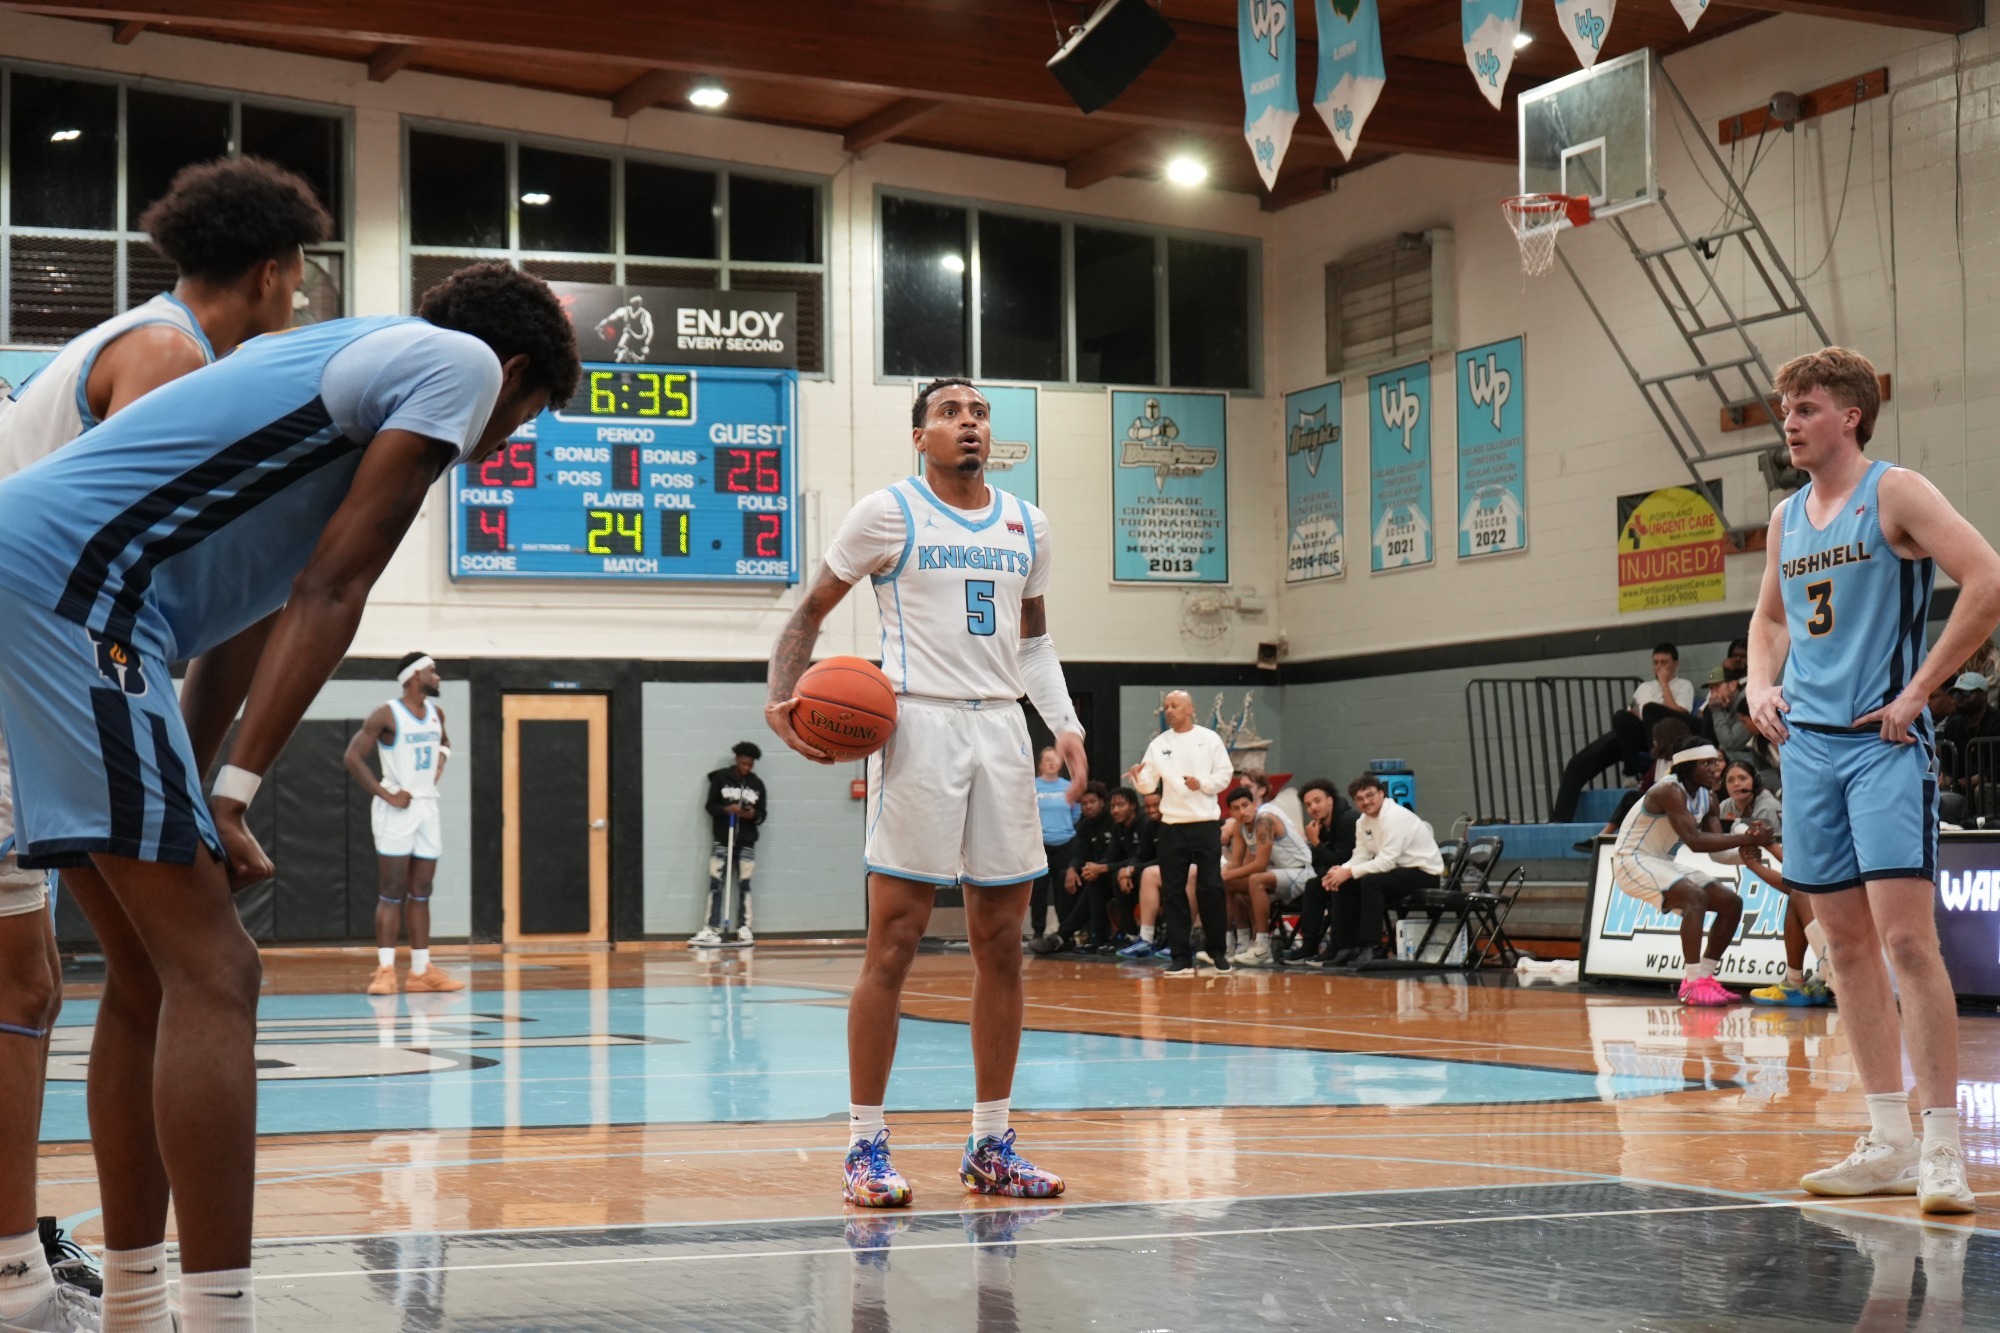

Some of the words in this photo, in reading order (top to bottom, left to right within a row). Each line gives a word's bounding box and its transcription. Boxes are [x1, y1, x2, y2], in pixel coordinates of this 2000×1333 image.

[677, 307, 785, 338] ENJOY
[677, 335, 723, 350] EVERY
[725, 338, 785, 352] SECOND
[590, 371, 689, 417] 6:35
[597, 427, 655, 443] PERIOD
[709, 422, 787, 445] GUEST
[554, 446, 611, 463] BONUS
[642, 449, 697, 465] BONUS
[630, 449, 639, 487] 1
[727, 449, 779, 493] 26
[557, 470, 602, 487] POSS
[650, 473, 695, 488] POSS
[460, 489, 515, 505] FOULS
[583, 492, 644, 508] PLAYER
[654, 493, 696, 509] FOUL
[737, 495, 788, 511] FOULS
[1137, 496, 1203, 506] CASCADE
[1122, 507, 1219, 517] CONFERENCE
[1650, 507, 1693, 521] PORTLAND
[480, 510, 506, 549] 4
[1119, 518, 1223, 528] TOURNAMENT
[1386, 524, 1416, 537] SOCCER
[1474, 515, 1507, 530] SOCCER
[1650, 518, 1686, 536] URGENT
[1688, 513, 1715, 530] CARE
[588, 511, 642, 554] 24
[679, 514, 688, 554] 1
[756, 514, 780, 557] 2
[1128, 529, 1213, 540] CHAMPIONS
[1476, 528, 1506, 547] 2022
[1387, 538, 1414, 556] 2021
[460, 555, 517, 571] SCORE
[603, 558, 658, 573] MATCH
[735, 560, 790, 575] SCORE
[918, 545, 1029, 577] KNIGHTS
[1149, 559, 1193, 572] 2013
[1621, 545, 1721, 582] INJURED?
[1781, 541, 1872, 580] BUSHNELL
[965, 579, 996, 636] 5
[1806, 578, 1835, 638] 3
[808, 709, 878, 740] SPALDING
